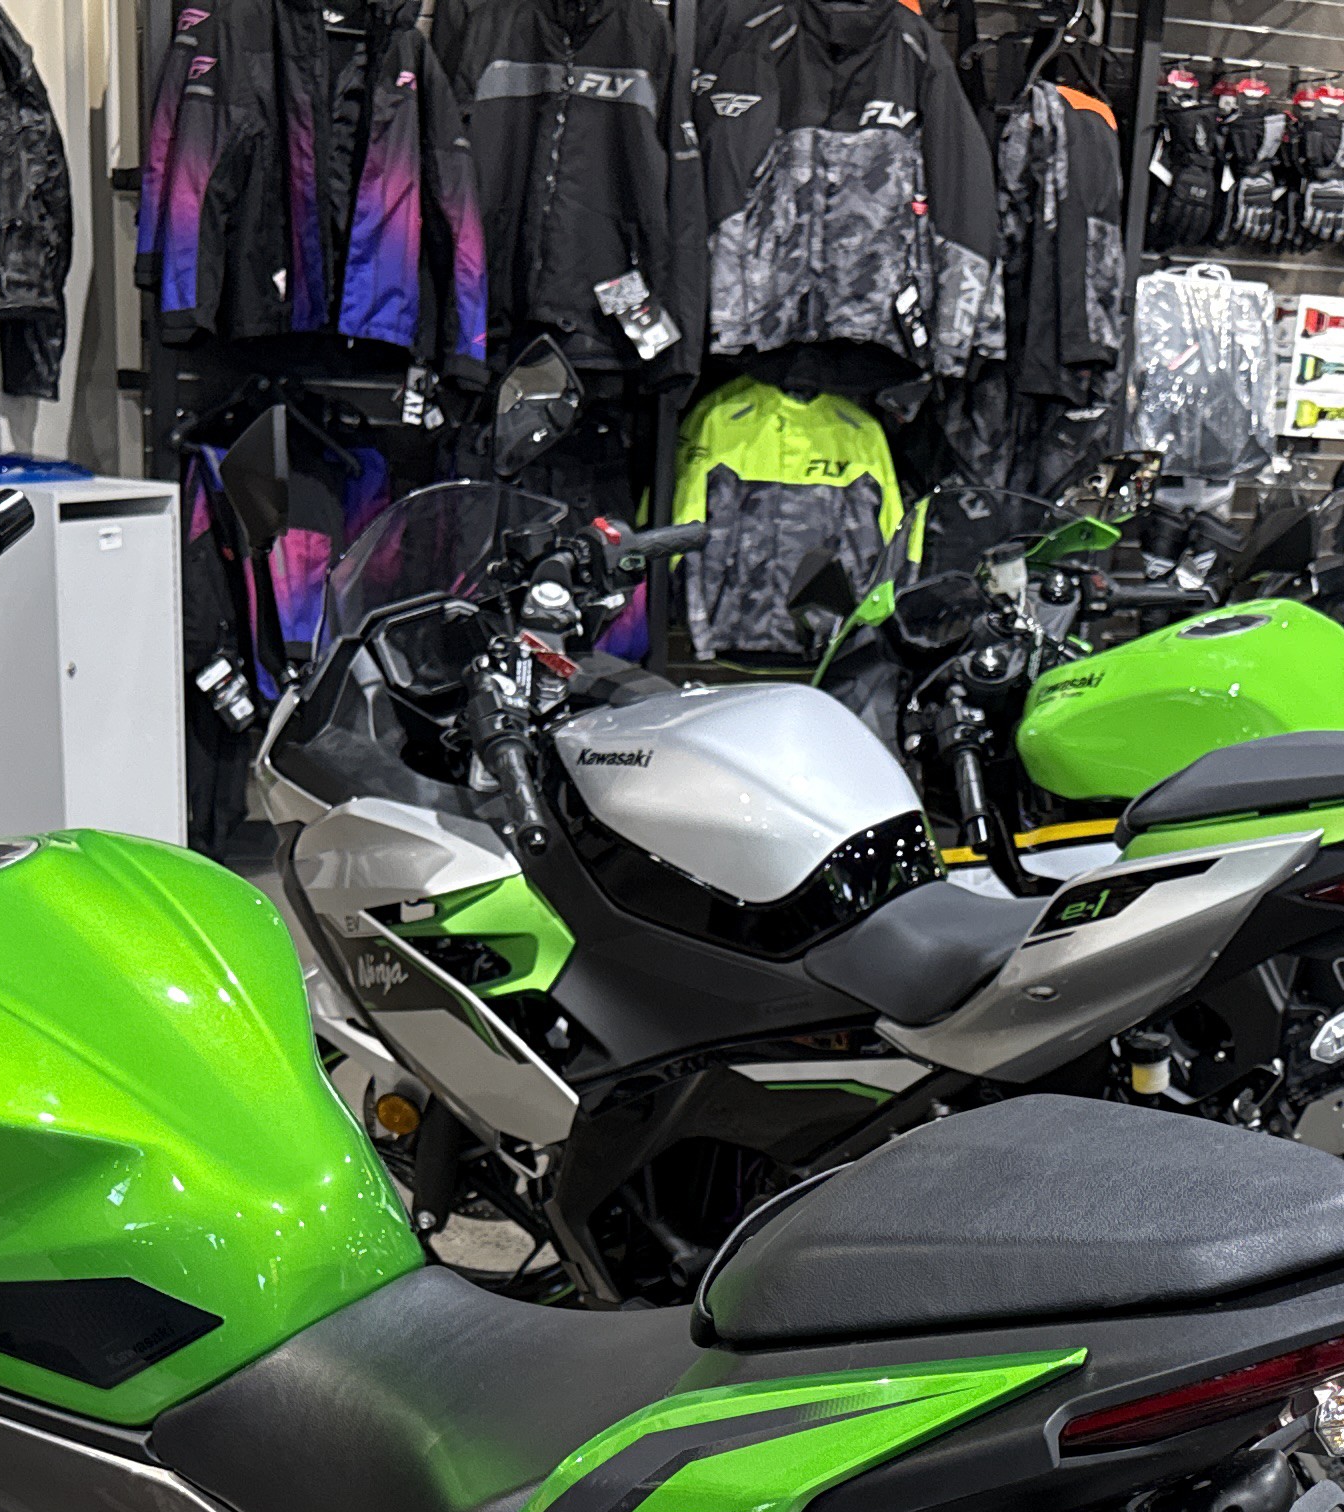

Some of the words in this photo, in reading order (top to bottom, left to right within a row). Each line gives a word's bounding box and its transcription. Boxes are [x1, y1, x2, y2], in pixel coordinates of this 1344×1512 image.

[578, 72, 635, 98] FLY
[858, 100, 917, 128] FLY
[806, 458, 850, 478] FLY
[576, 747, 654, 769] Kawasaki
[1061, 888, 1112, 921] e-1
[358, 951, 409, 997] Ninja
